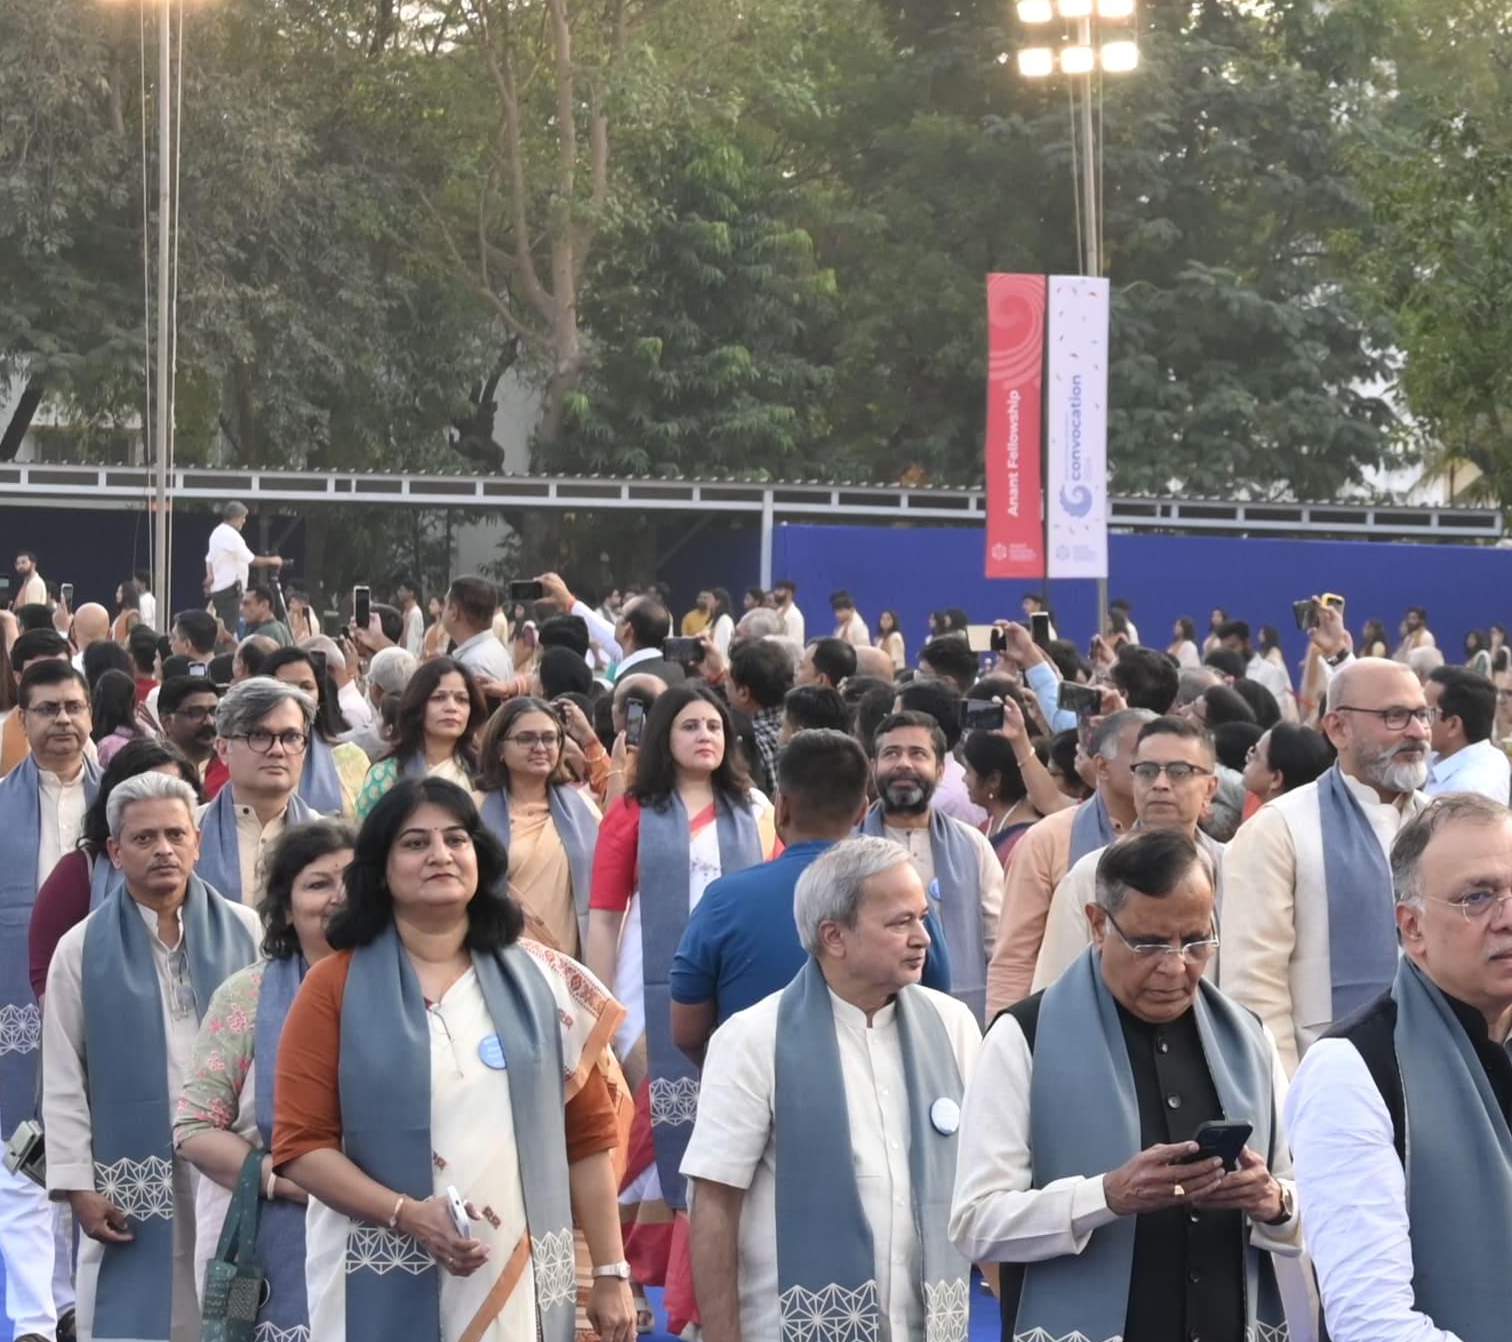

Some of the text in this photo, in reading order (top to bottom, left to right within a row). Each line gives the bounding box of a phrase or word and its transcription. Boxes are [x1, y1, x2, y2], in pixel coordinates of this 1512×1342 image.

[1007, 390, 1021, 517] Anant Fellowship
[1068, 375, 1081, 481] convocation
